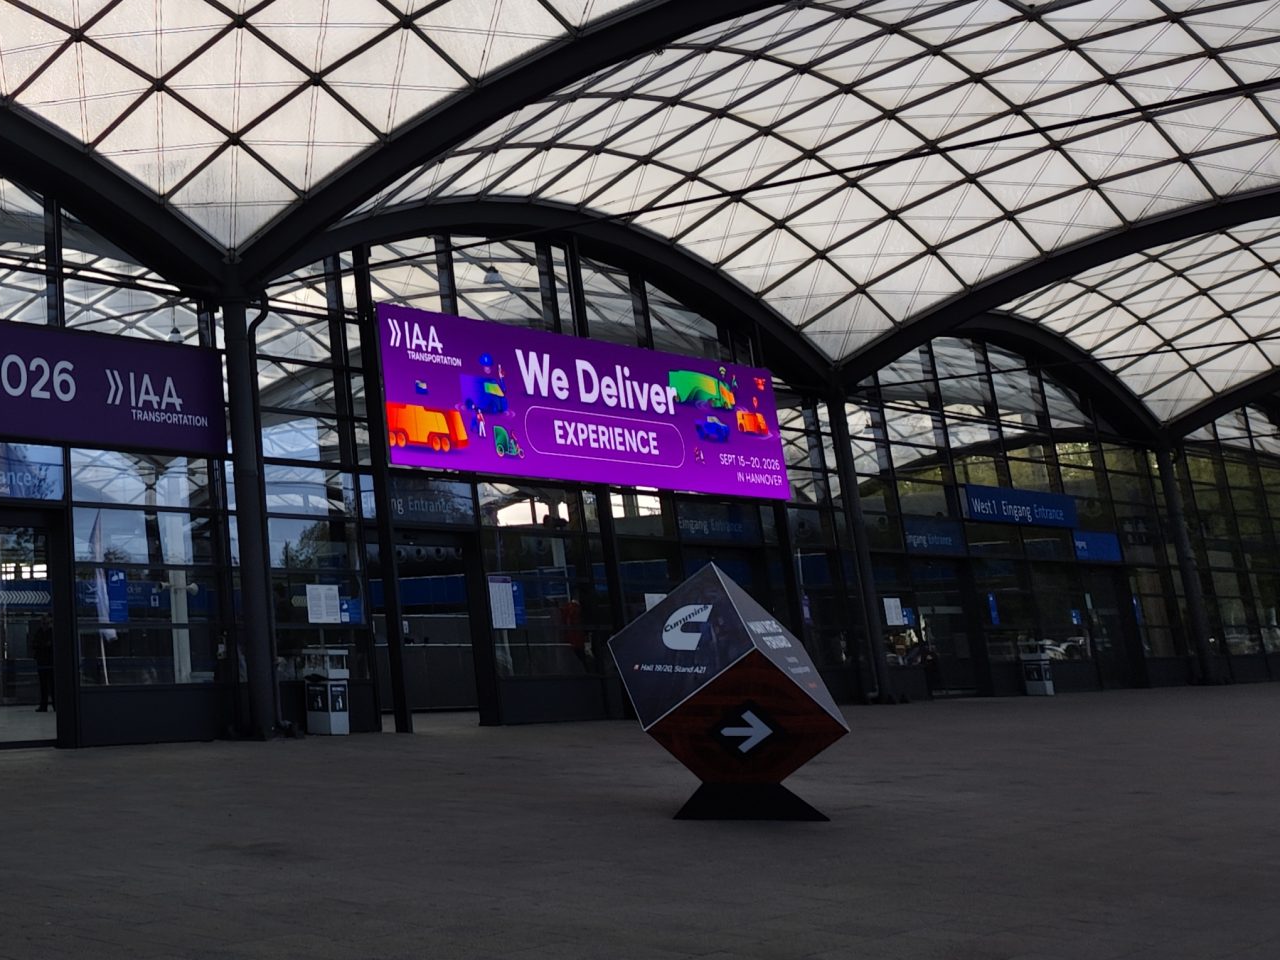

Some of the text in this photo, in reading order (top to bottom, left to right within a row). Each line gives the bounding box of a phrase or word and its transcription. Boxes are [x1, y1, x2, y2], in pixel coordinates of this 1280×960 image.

[404, 321, 444, 354] IAA
[407, 350, 462, 368] TRANSPORTATION
[129, 371, 183, 411] IAA
[515, 348, 677, 415] We Deliver
[131, 408, 209, 427] TRANSPORTATION
[554, 419, 660, 456] EXPERIENCE
[719, 452, 736, 465] SEPT
[763, 457, 781, 471] 2026
[736, 471, 783, 486] IN HANNOVER
[1001, 500, 1033, 522] Eingang
[1033, 503, 1065, 521] Entrance
[663, 605, 710, 632] Cummins
[640, 663, 654, 672] Hall
[673, 664, 694, 673] Stand
